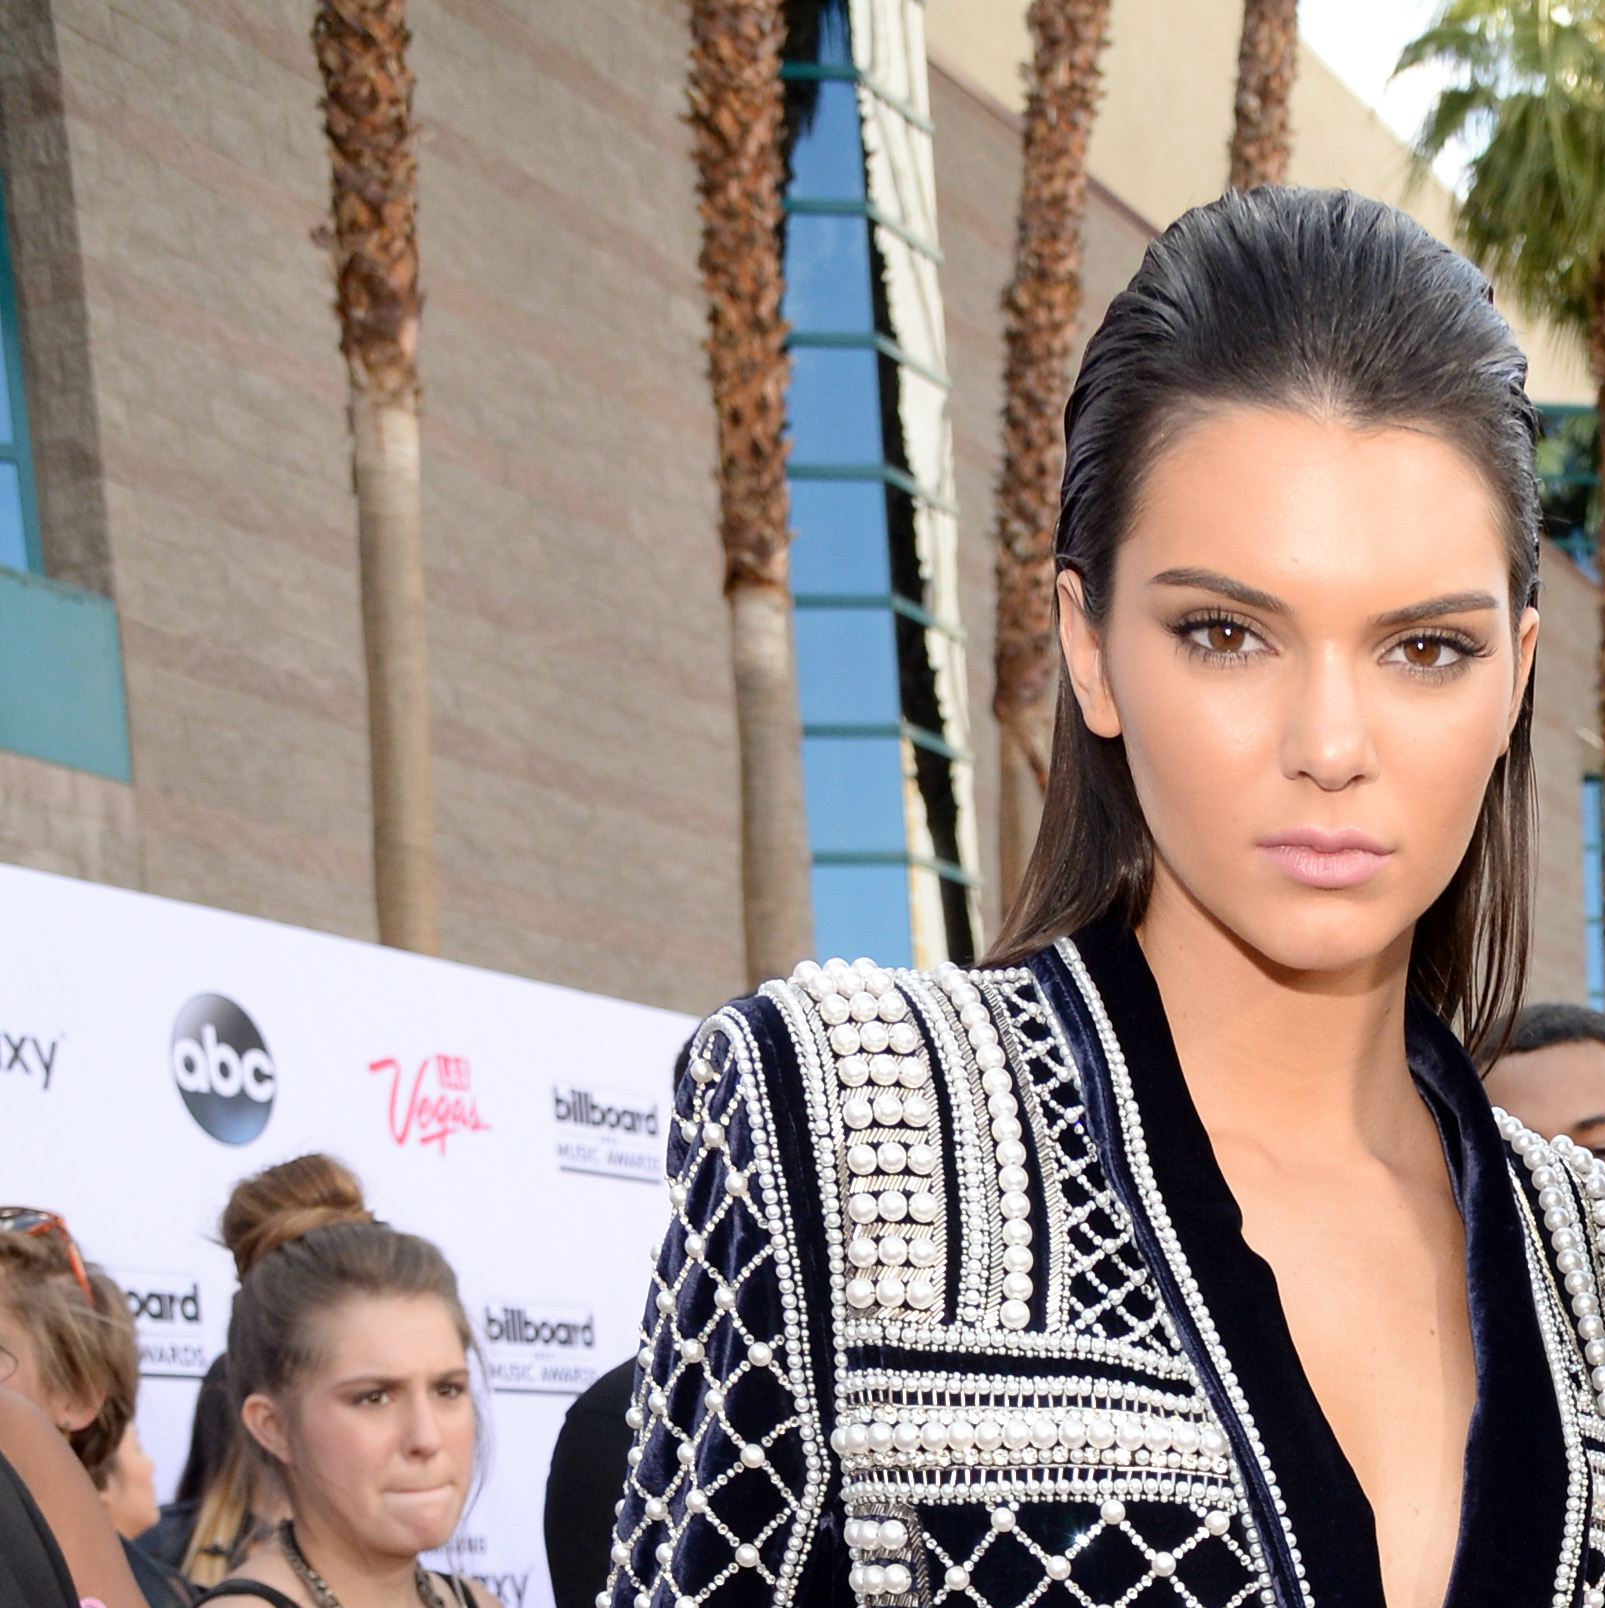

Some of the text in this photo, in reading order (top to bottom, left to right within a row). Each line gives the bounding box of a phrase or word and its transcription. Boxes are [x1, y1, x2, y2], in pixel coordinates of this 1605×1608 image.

[173, 1023, 276, 1103] abc
[369, 1057, 492, 1156] Vegas
[552, 1085, 659, 1136] billboard
[127, 1282, 201, 1322] oard
[485, 1306, 595, 1348] billboard
[138, 1346, 206, 1369] WARDS
